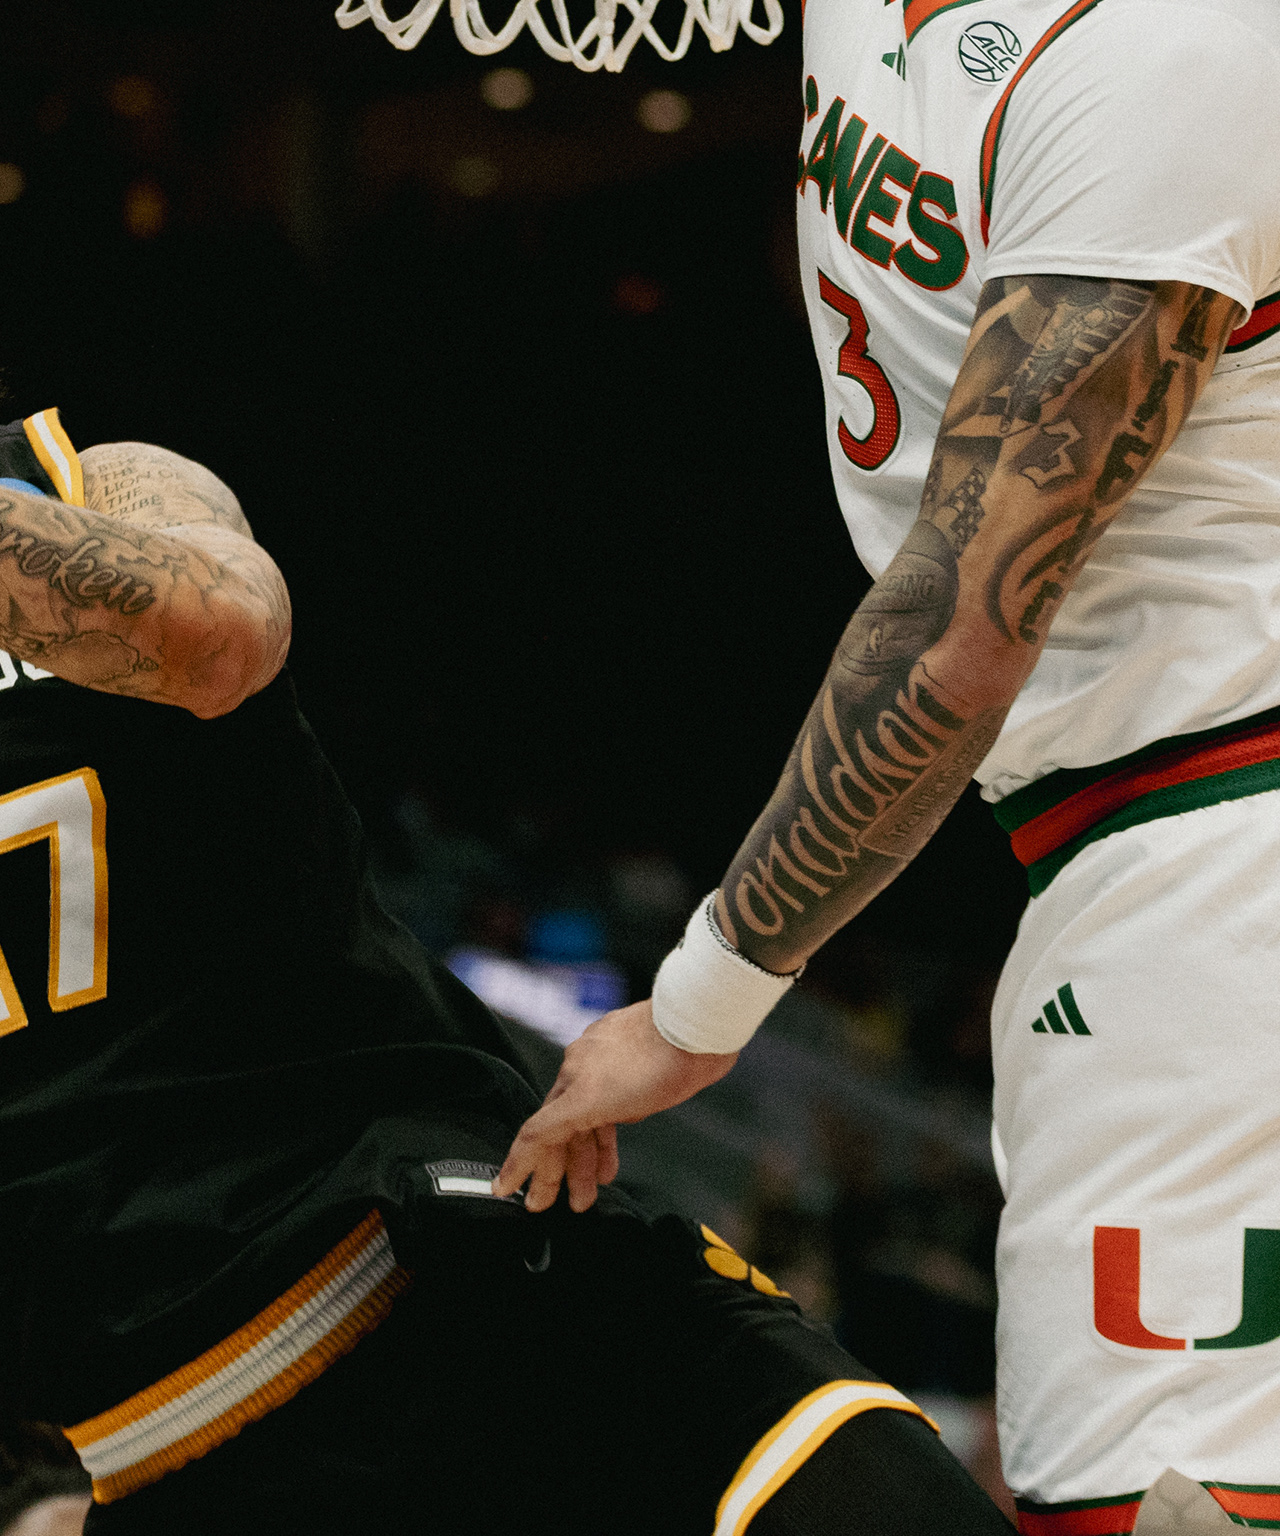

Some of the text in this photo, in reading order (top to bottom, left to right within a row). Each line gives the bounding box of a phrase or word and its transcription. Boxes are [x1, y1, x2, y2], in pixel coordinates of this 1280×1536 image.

[969, 34, 1016, 71] ACC
[817, 267, 901, 471] 3
[104, 471, 151, 497] LION
[105, 486, 142, 509] THE
